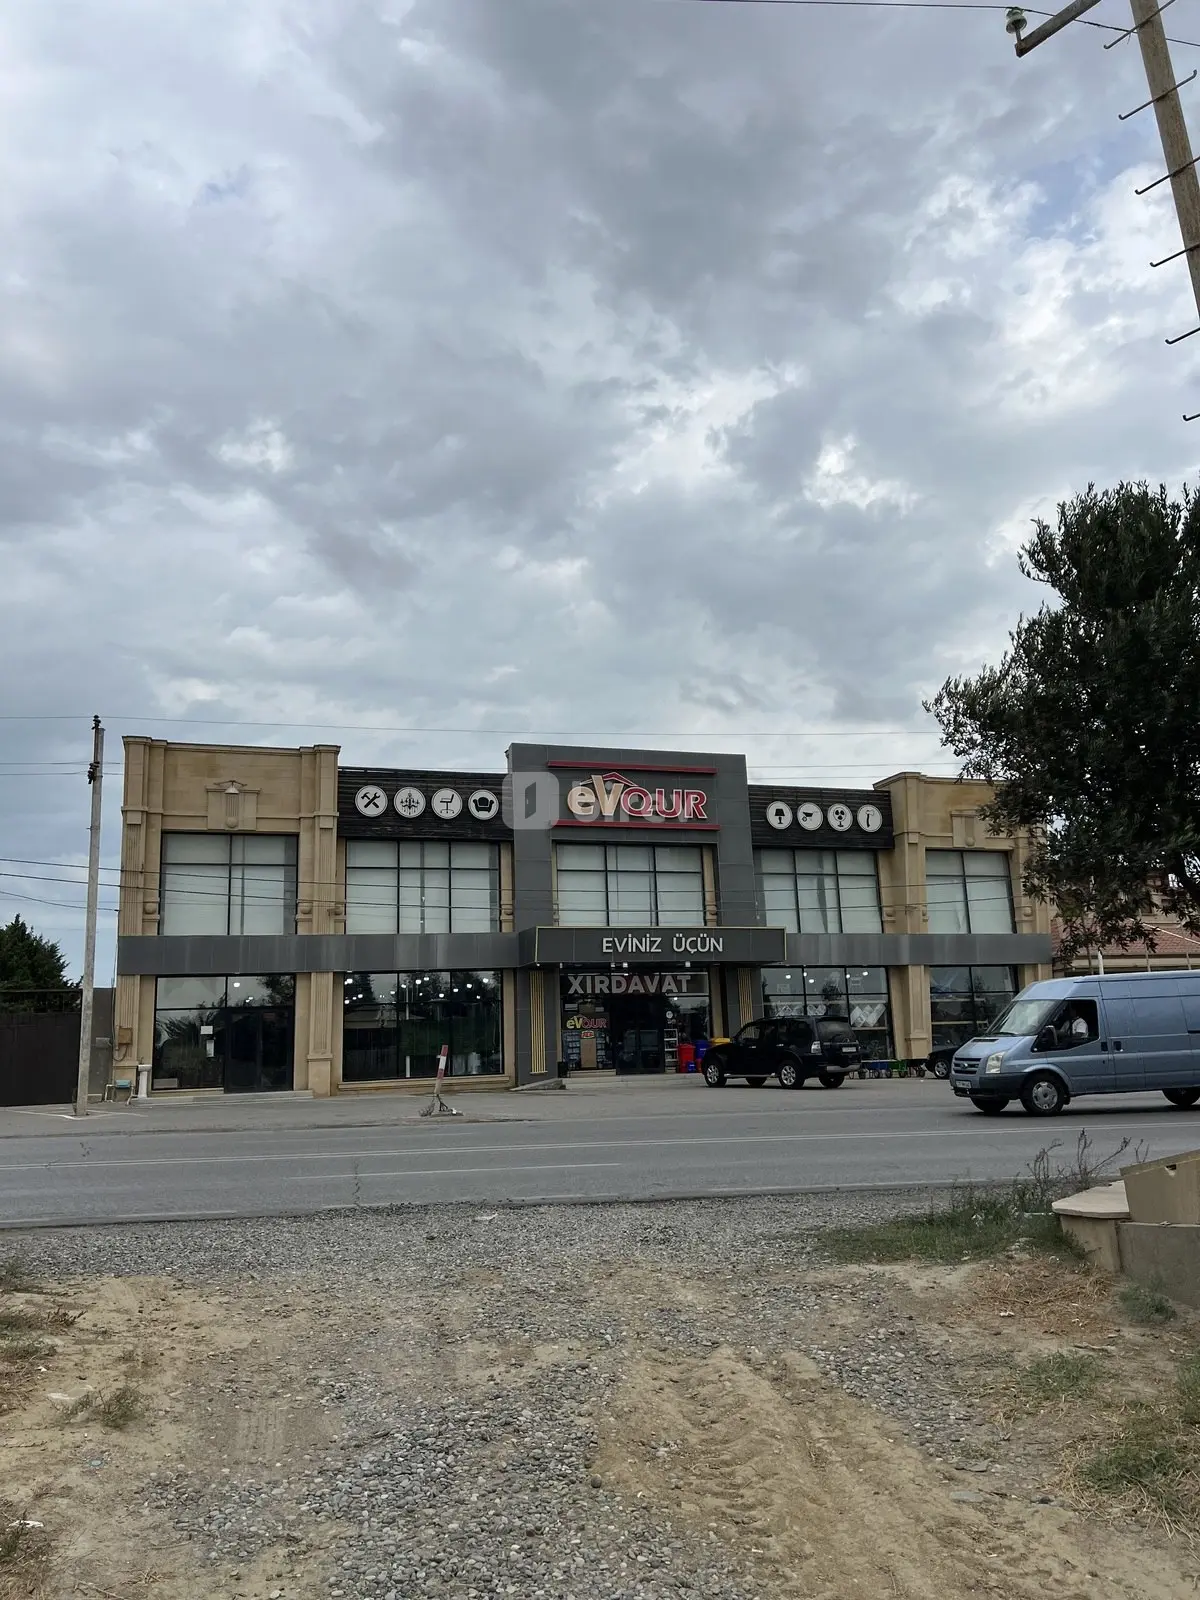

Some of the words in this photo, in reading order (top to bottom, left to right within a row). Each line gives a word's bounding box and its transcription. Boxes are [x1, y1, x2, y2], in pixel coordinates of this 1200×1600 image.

[602, 934, 662, 953] EVİNİZ
[673, 933, 723, 954] ÜÇÜN
[568, 975, 691, 994] XIRDAVAT
